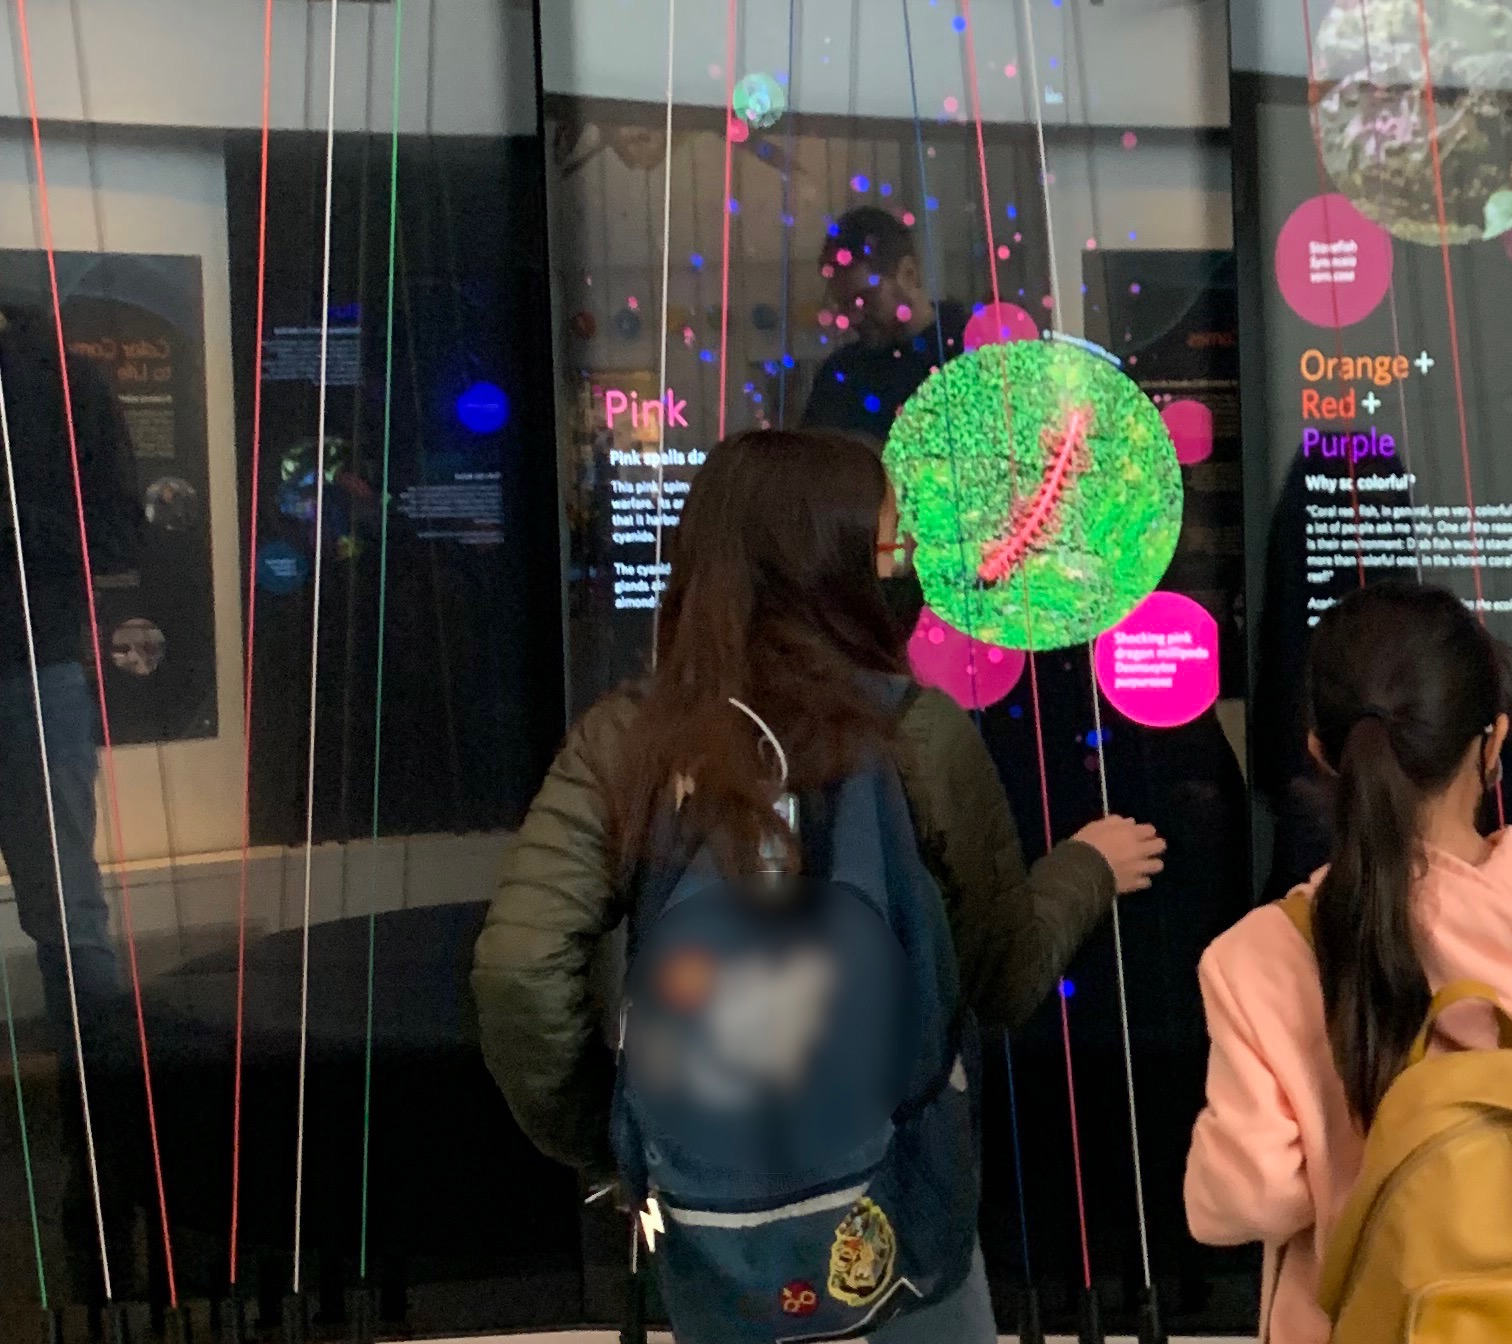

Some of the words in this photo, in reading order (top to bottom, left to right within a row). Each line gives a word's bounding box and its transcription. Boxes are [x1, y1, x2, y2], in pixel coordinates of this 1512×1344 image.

[1301, 349, 1409, 386] Orange
[605, 388, 689, 429] Pink
[1302, 388, 1357, 420] Red
[609, 449, 641, 468] Pink
[1303, 426, 1396, 463] Purple
[1305, 474, 1338, 494] Why
